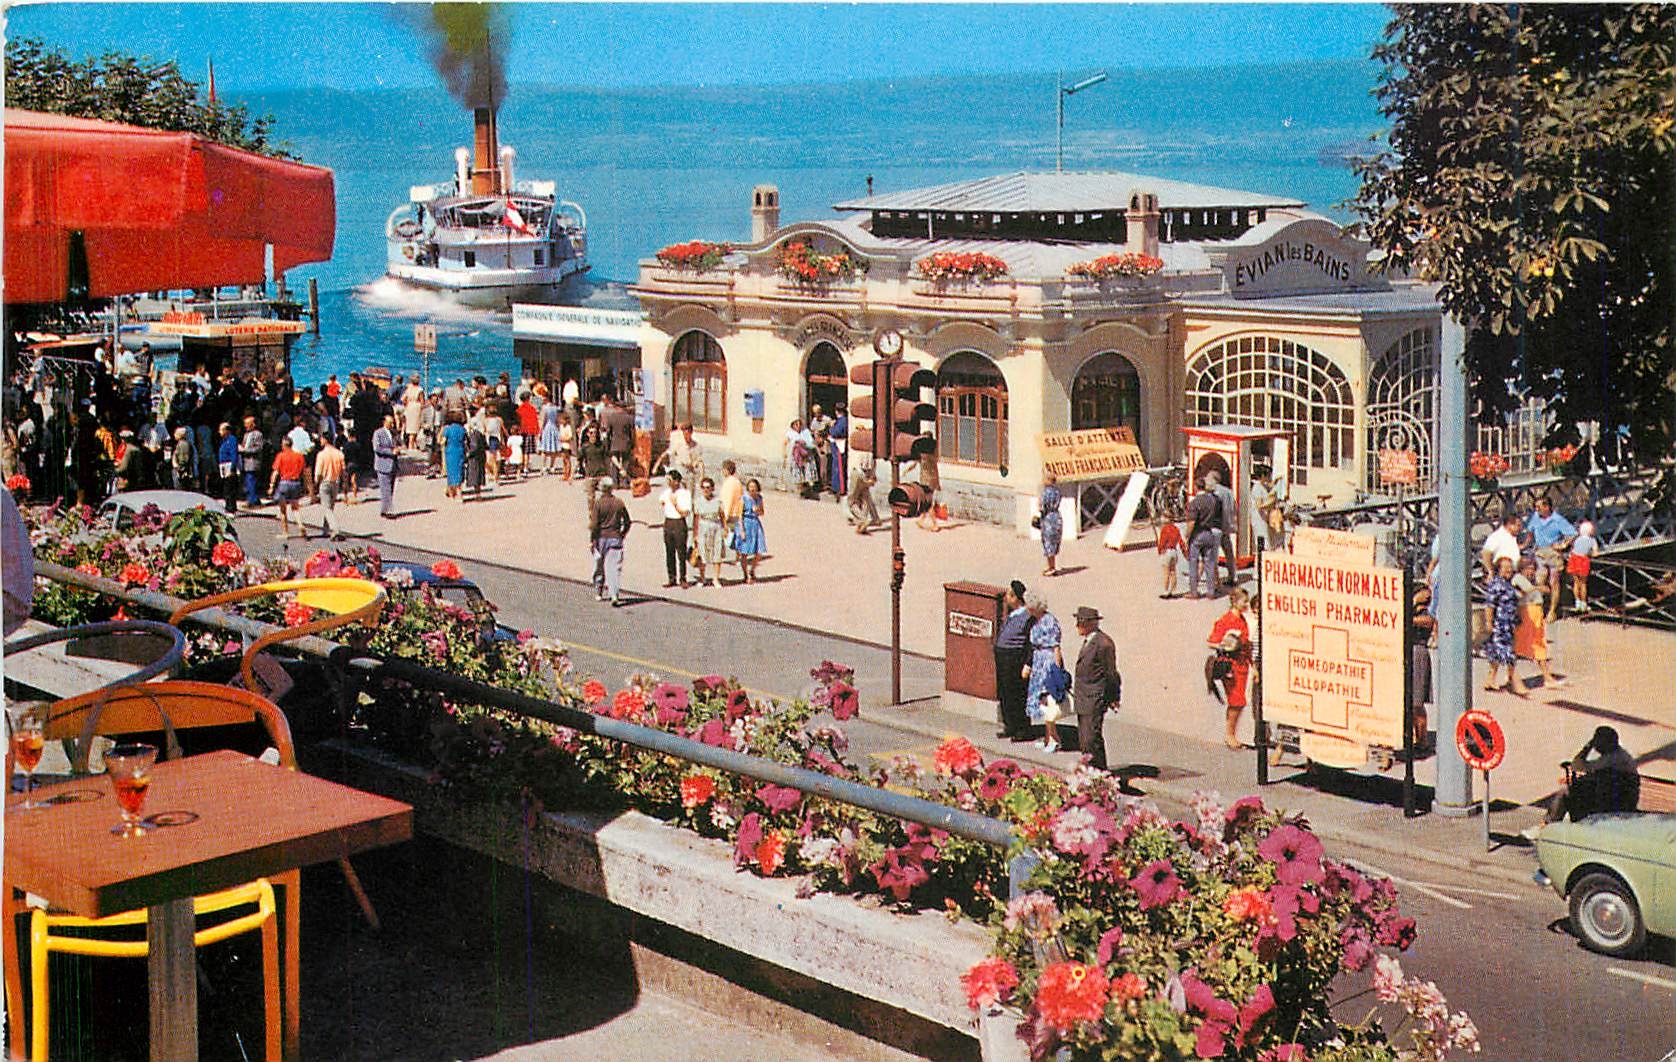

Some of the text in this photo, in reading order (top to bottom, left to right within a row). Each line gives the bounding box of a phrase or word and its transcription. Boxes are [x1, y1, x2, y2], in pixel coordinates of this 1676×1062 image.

[1236, 241, 1350, 287] ÉVIAN les BAINS
[1044, 434, 1074, 448] SALLE
[1264, 559, 1398, 601] PHARMACIE NORMALE
[1267, 593, 1397, 629] ENGLISH PHARMACY
[1293, 656, 1366, 680] HOMEOPATHIE
[1293, 676, 1361, 699] ALLOPATHIE
